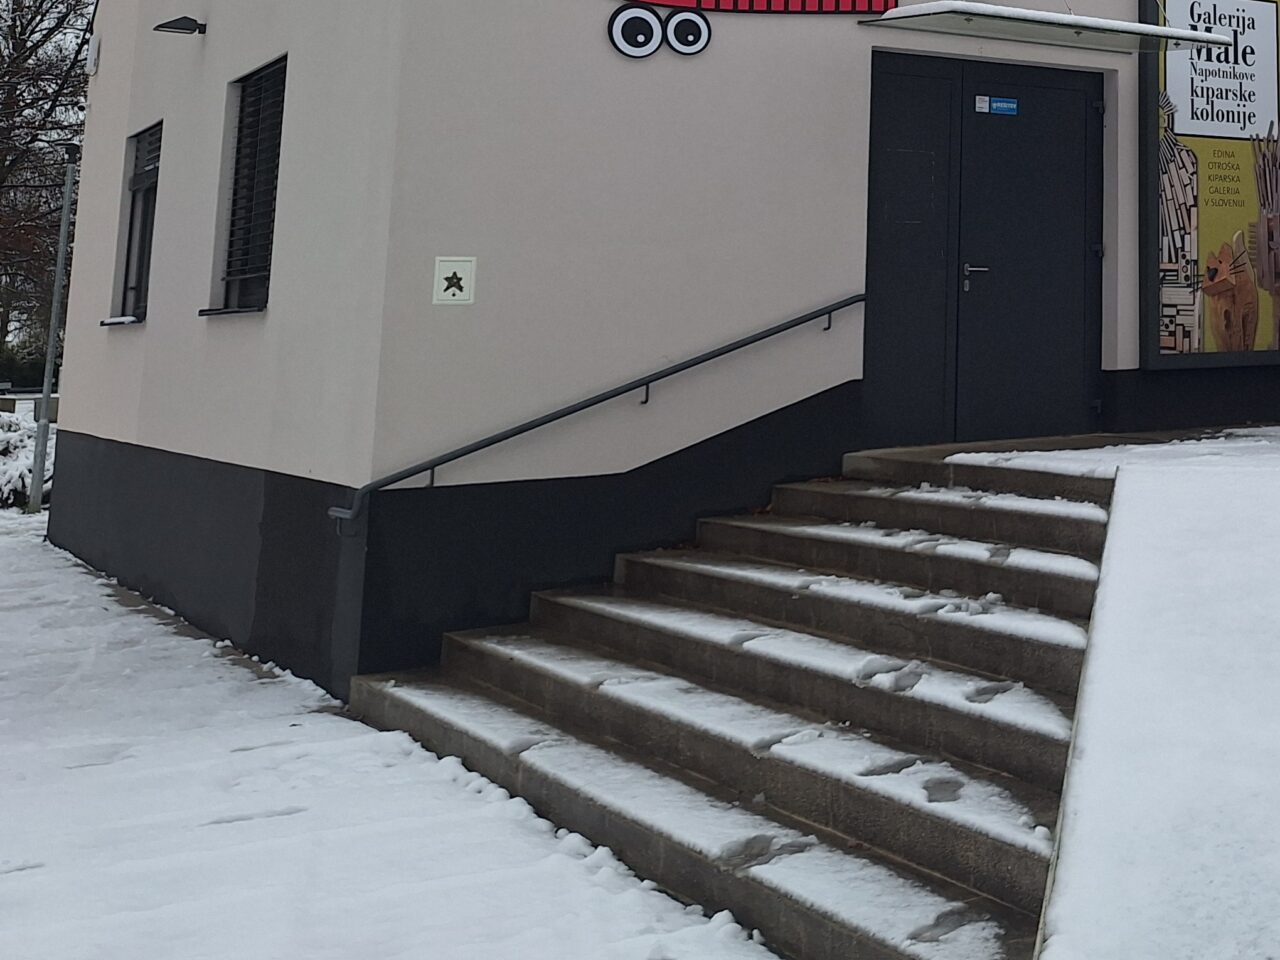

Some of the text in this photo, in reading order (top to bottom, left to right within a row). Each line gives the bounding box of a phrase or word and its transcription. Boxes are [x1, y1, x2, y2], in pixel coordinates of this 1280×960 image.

[1189, 0, 1256, 35] Galerija
[1188, 24, 1256, 67] Male
[1190, 61, 1256, 82] Napotnikove
[1190, 77, 1256, 105] kiparske
[1190, 98, 1256, 131] kolonije
[1212, 149, 1235, 158] EDINA
[1207, 161, 1241, 171] OTROŠKA
[1207, 174, 1241, 183] KIPARSKA
[1208, 186, 1240, 195] GALERIJA
[1203, 198, 1245, 208] V SLOVENIJI
